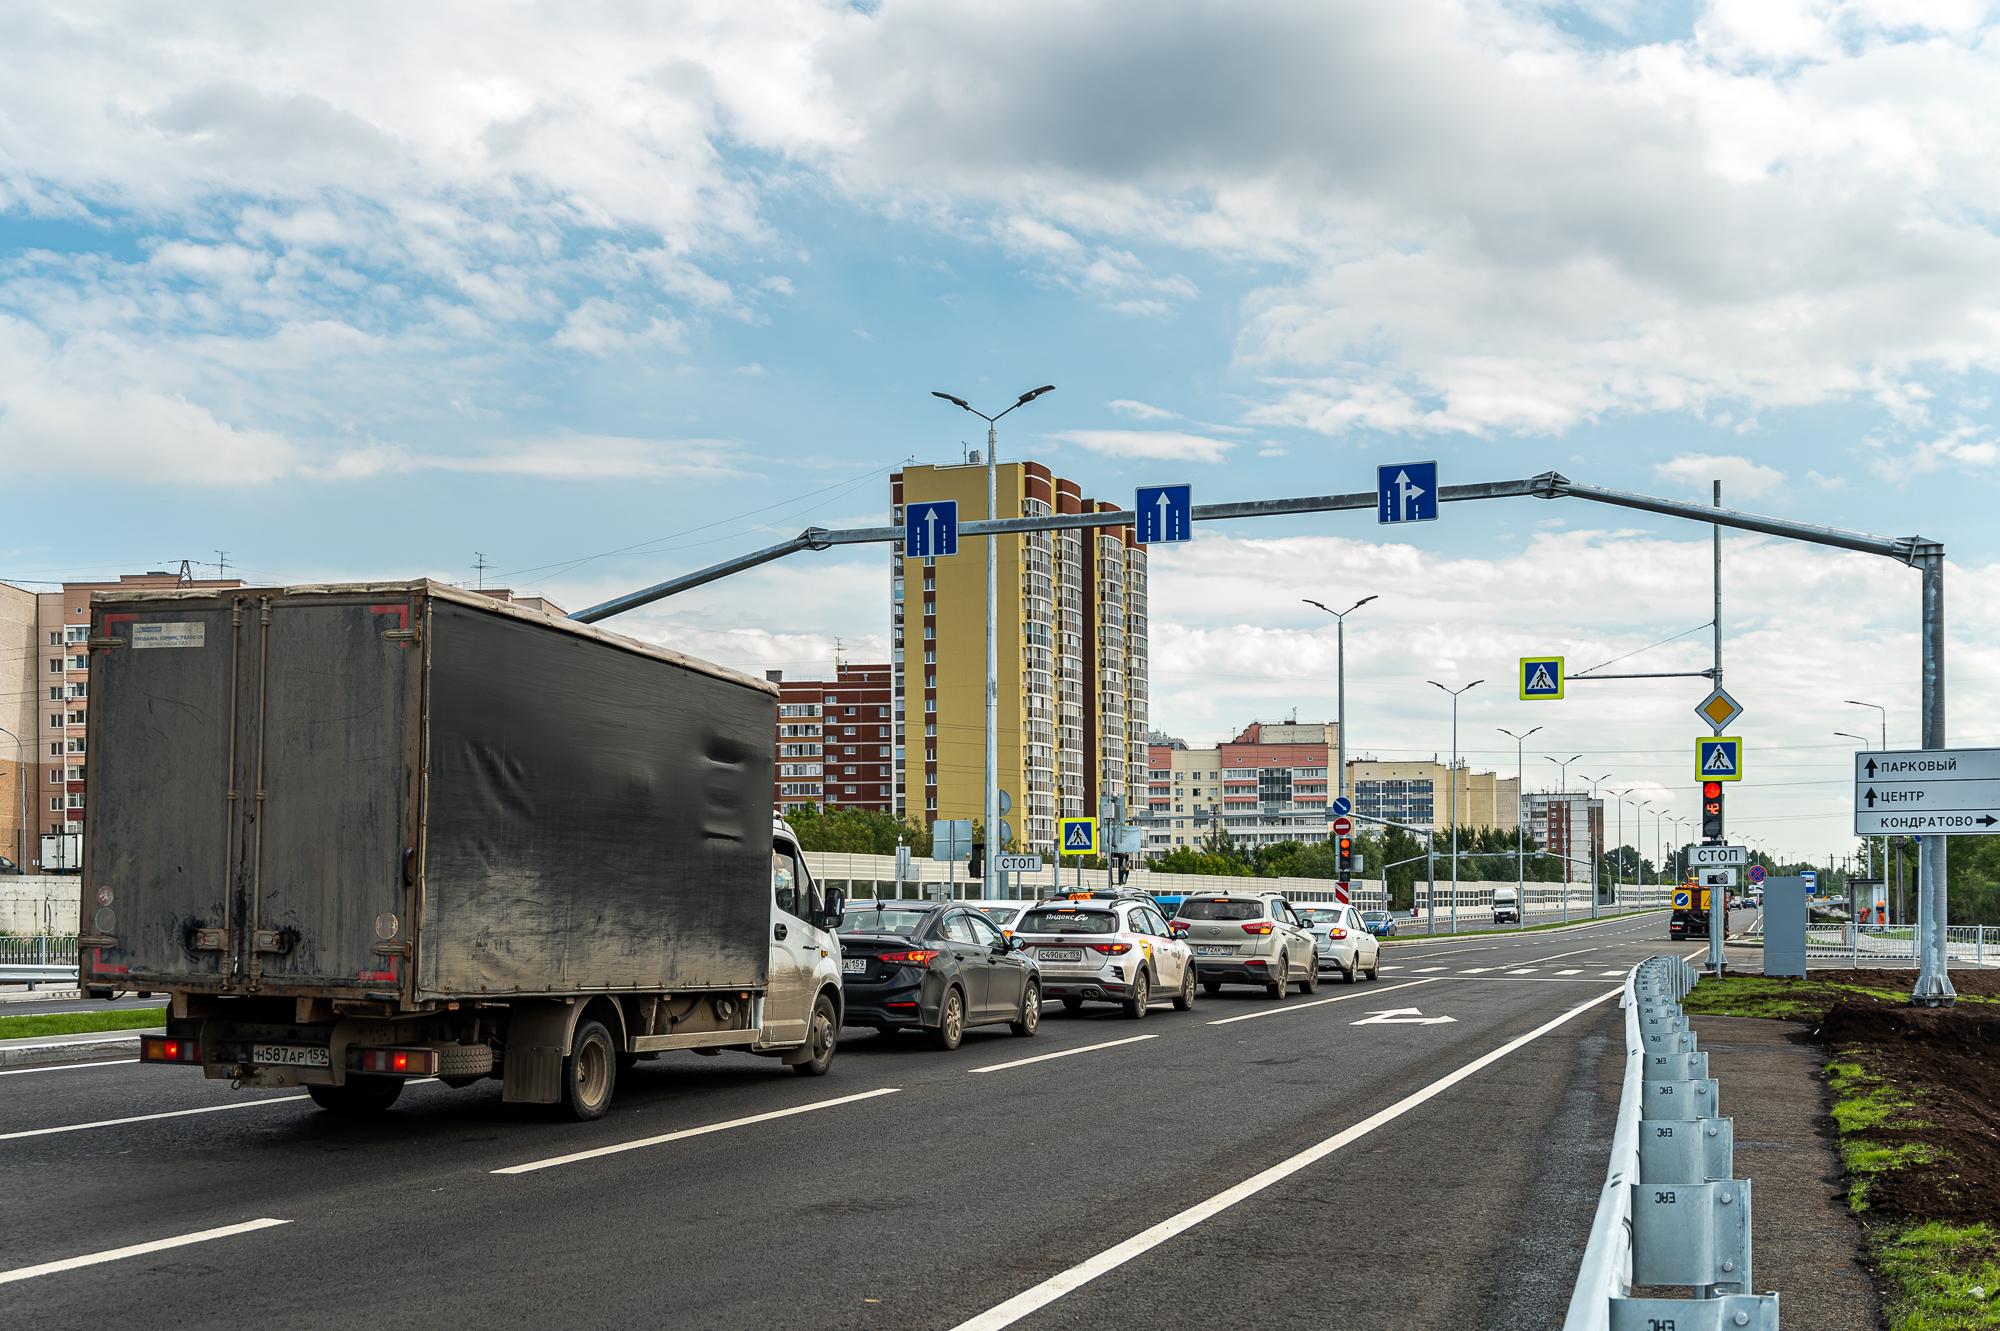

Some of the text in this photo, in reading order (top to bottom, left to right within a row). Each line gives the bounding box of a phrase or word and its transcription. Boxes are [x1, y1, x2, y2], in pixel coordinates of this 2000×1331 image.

[1881, 758, 1957, 772] ПАРКОВЫЙ
[1881, 791, 1925, 803] ЦЕНТР
[1707, 803, 1719, 814] 42
[1880, 816, 1973, 828] КОНДРАТОВО
[1698, 850, 1738, 862] СТОП
[1002, 858, 1035, 869] СТОП
[851, 959, 864, 967] 159
[257, 1048, 326, 1063] Н587АР 159
[1659, 1086, 1673, 1094] EAC
[1657, 1127, 1673, 1137] EAC
[1655, 1191, 1676, 1203] EAC
